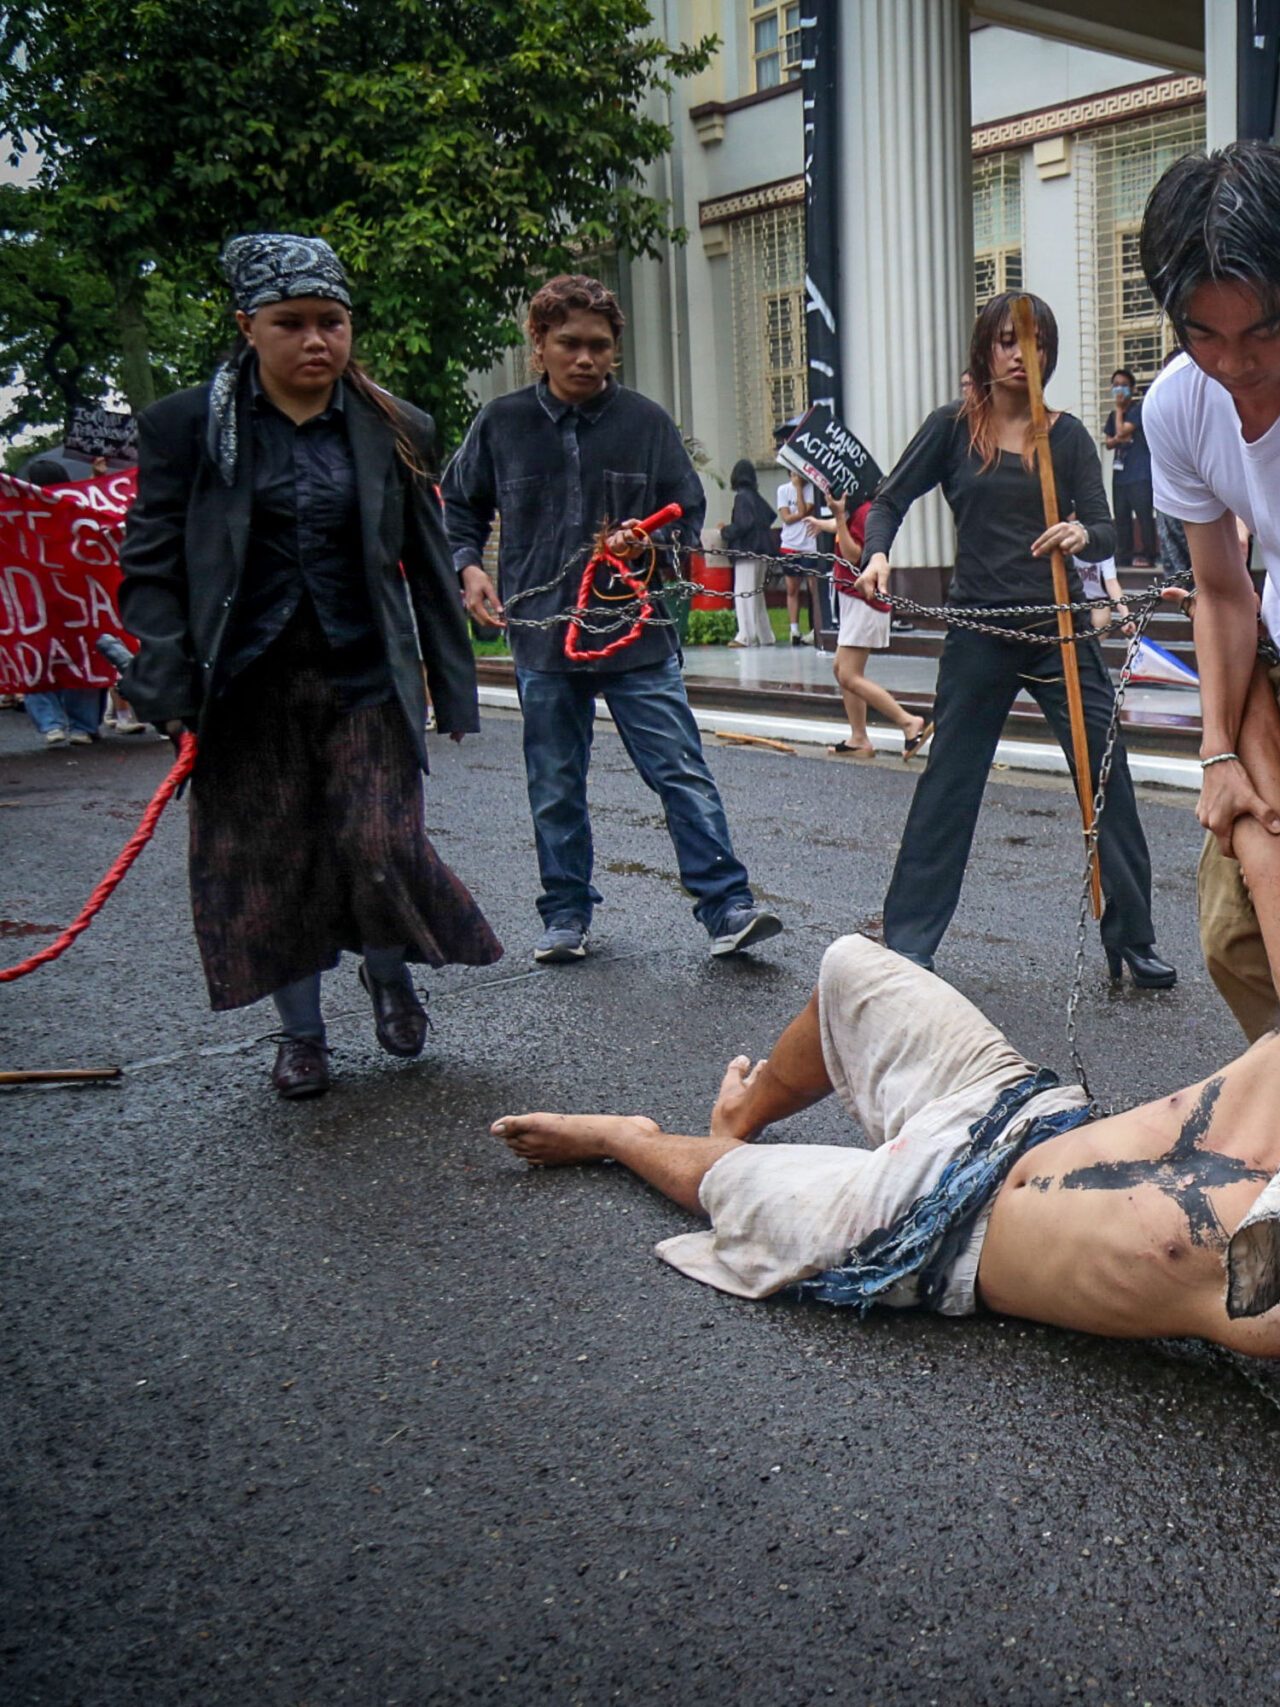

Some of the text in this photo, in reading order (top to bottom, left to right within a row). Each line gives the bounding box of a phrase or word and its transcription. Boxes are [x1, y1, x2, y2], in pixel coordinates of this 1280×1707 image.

[796, 431, 859, 496] ACTIVISTS
[825, 421, 867, 468] HANDS
[52, 572, 123, 629] SA
